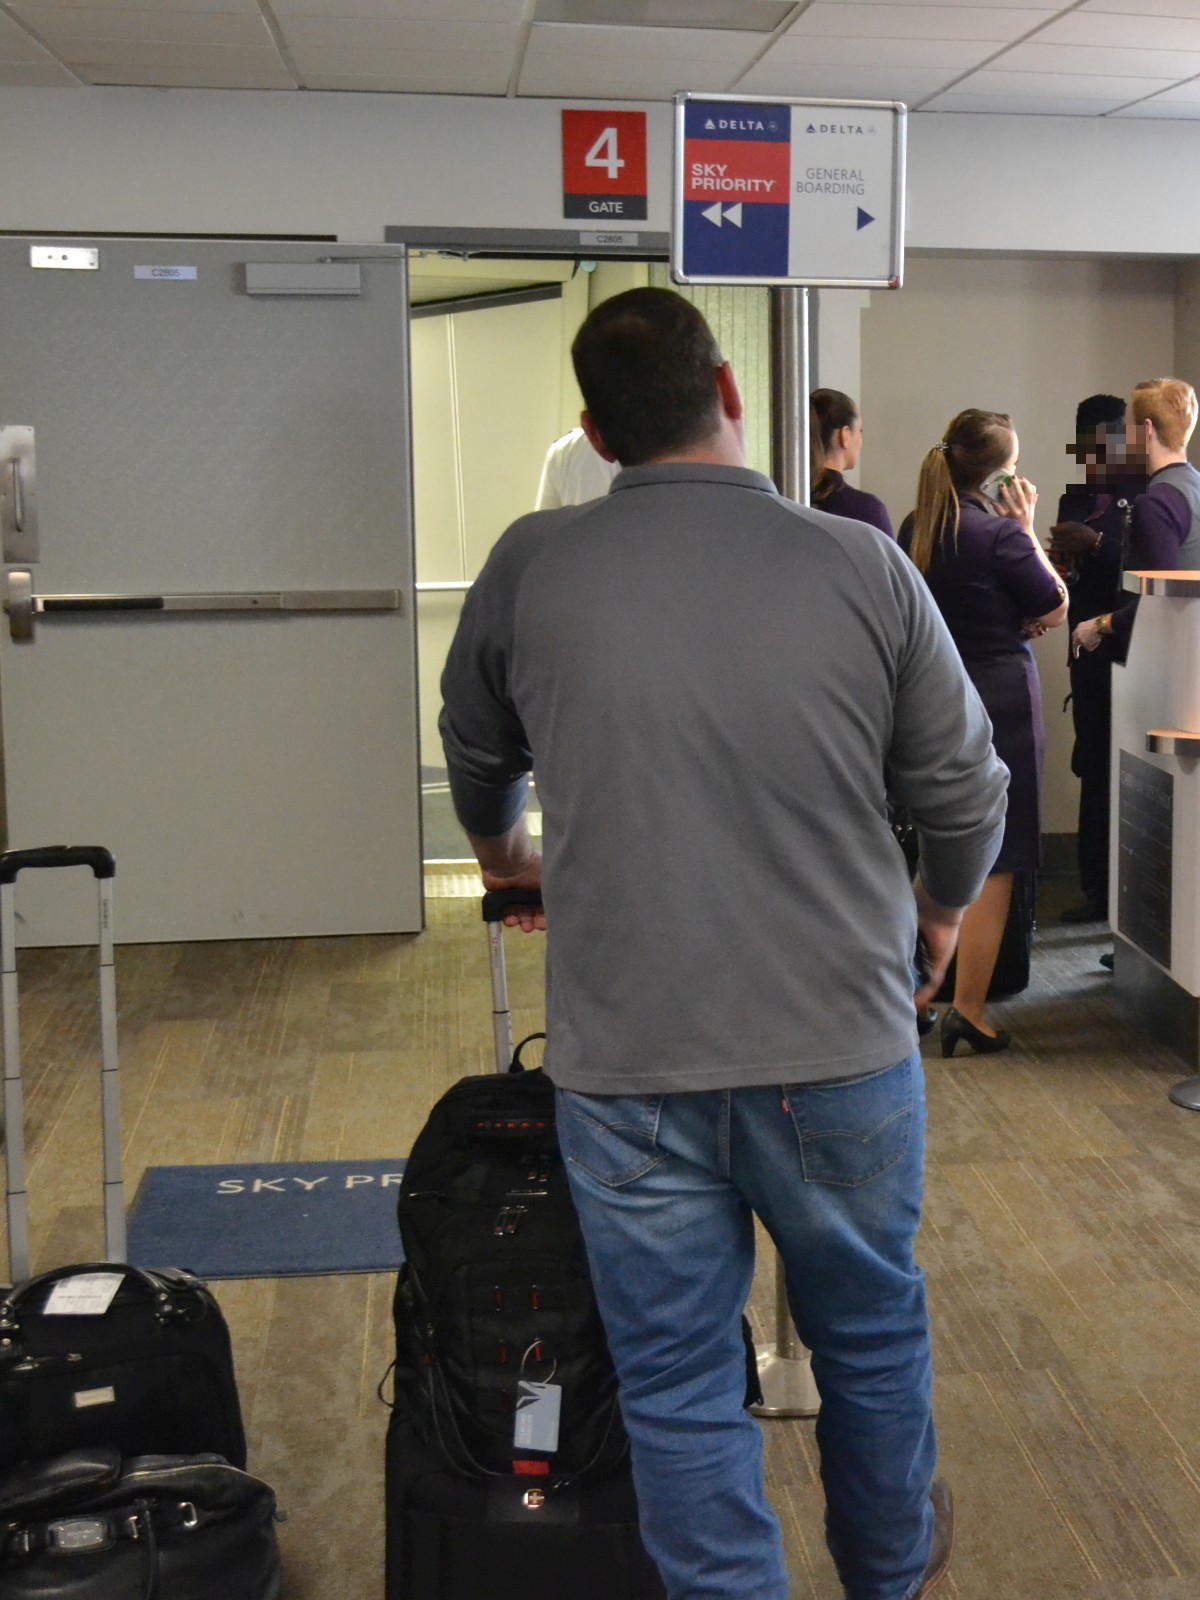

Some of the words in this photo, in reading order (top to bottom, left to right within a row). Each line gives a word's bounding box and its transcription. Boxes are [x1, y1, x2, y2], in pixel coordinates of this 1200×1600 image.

[719, 119, 764, 131] DELTA
[820, 124, 863, 135] DELTA
[585, 127, 625, 179] 4
[691, 163, 728, 177] SKY
[806, 167, 865, 181] GENERAL
[691, 177, 775, 192] PRIORITY
[796, 181, 866, 196] BOARDING
[588, 201, 624, 213] GATE
[216, 1176, 329, 1194] SKY
[345, 1173, 404, 1190] PR
